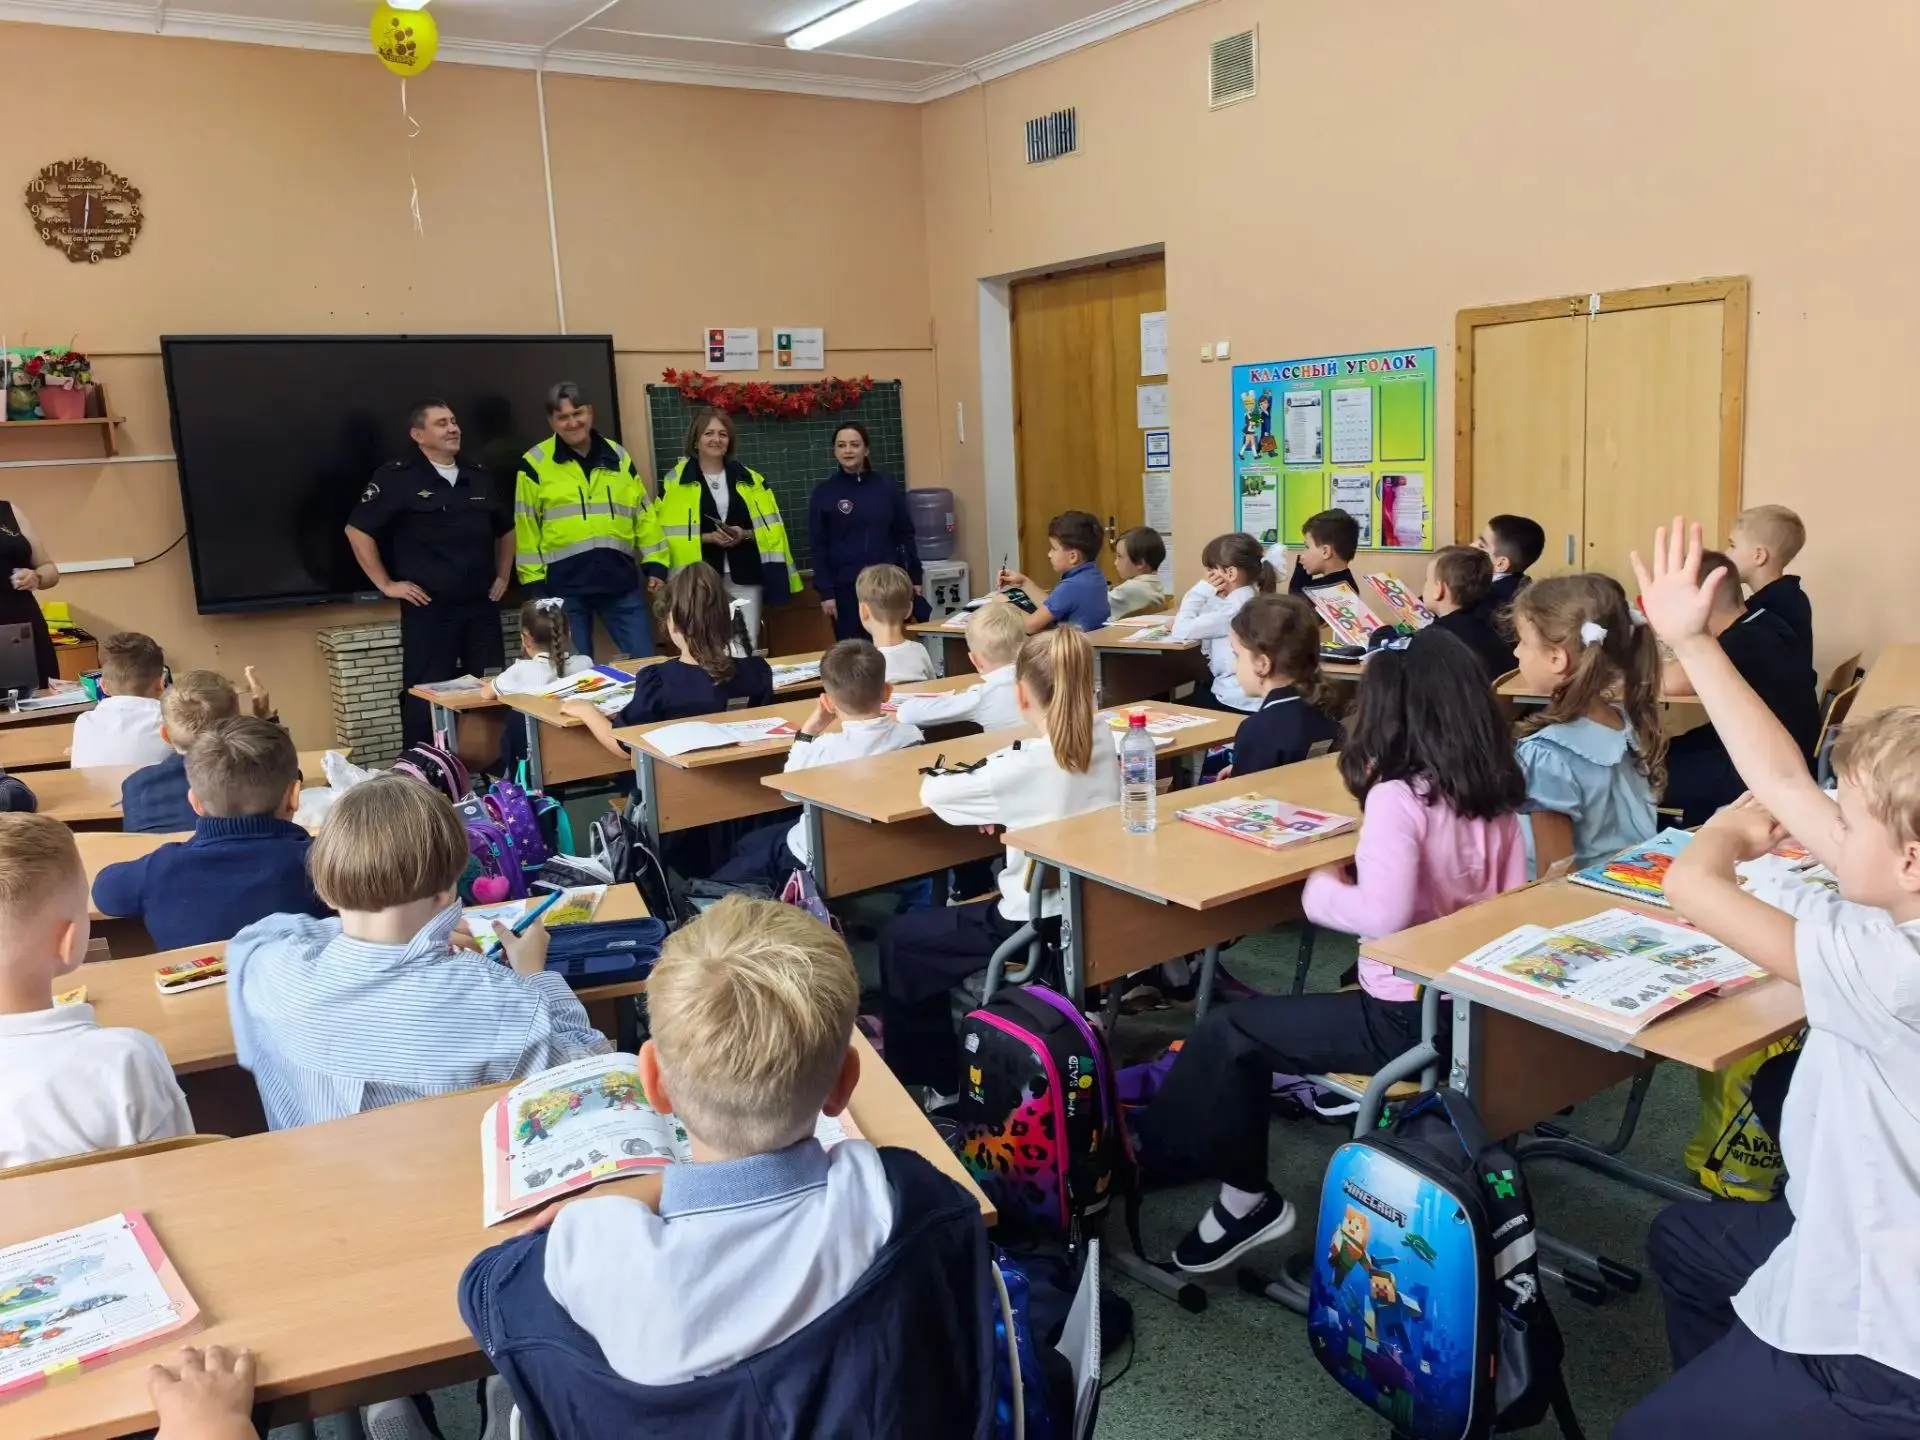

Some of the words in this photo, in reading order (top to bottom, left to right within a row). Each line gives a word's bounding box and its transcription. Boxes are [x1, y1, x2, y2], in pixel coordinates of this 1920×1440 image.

[49, 164, 58, 177] 11
[72, 160, 85, 171] 12
[101, 163, 106, 176] 1
[31, 180, 45, 193] 10
[121, 181, 130, 193] 2
[31, 204, 40, 217] 9
[131, 204, 140, 216] 3
[42, 228, 51, 240] 8
[128, 227, 137, 239] 4
[66, 242, 73, 255] 7
[114, 244, 122, 257] 5
[91, 249, 100, 262] 6
[1250, 359, 1338, 383] КЛАССНЫЙ
[1346, 354, 1418, 375] УГОЛОК
[1068, 1055, 1079, 1087] SAID
[1343, 1178, 1407, 1229] MINECRAFT
